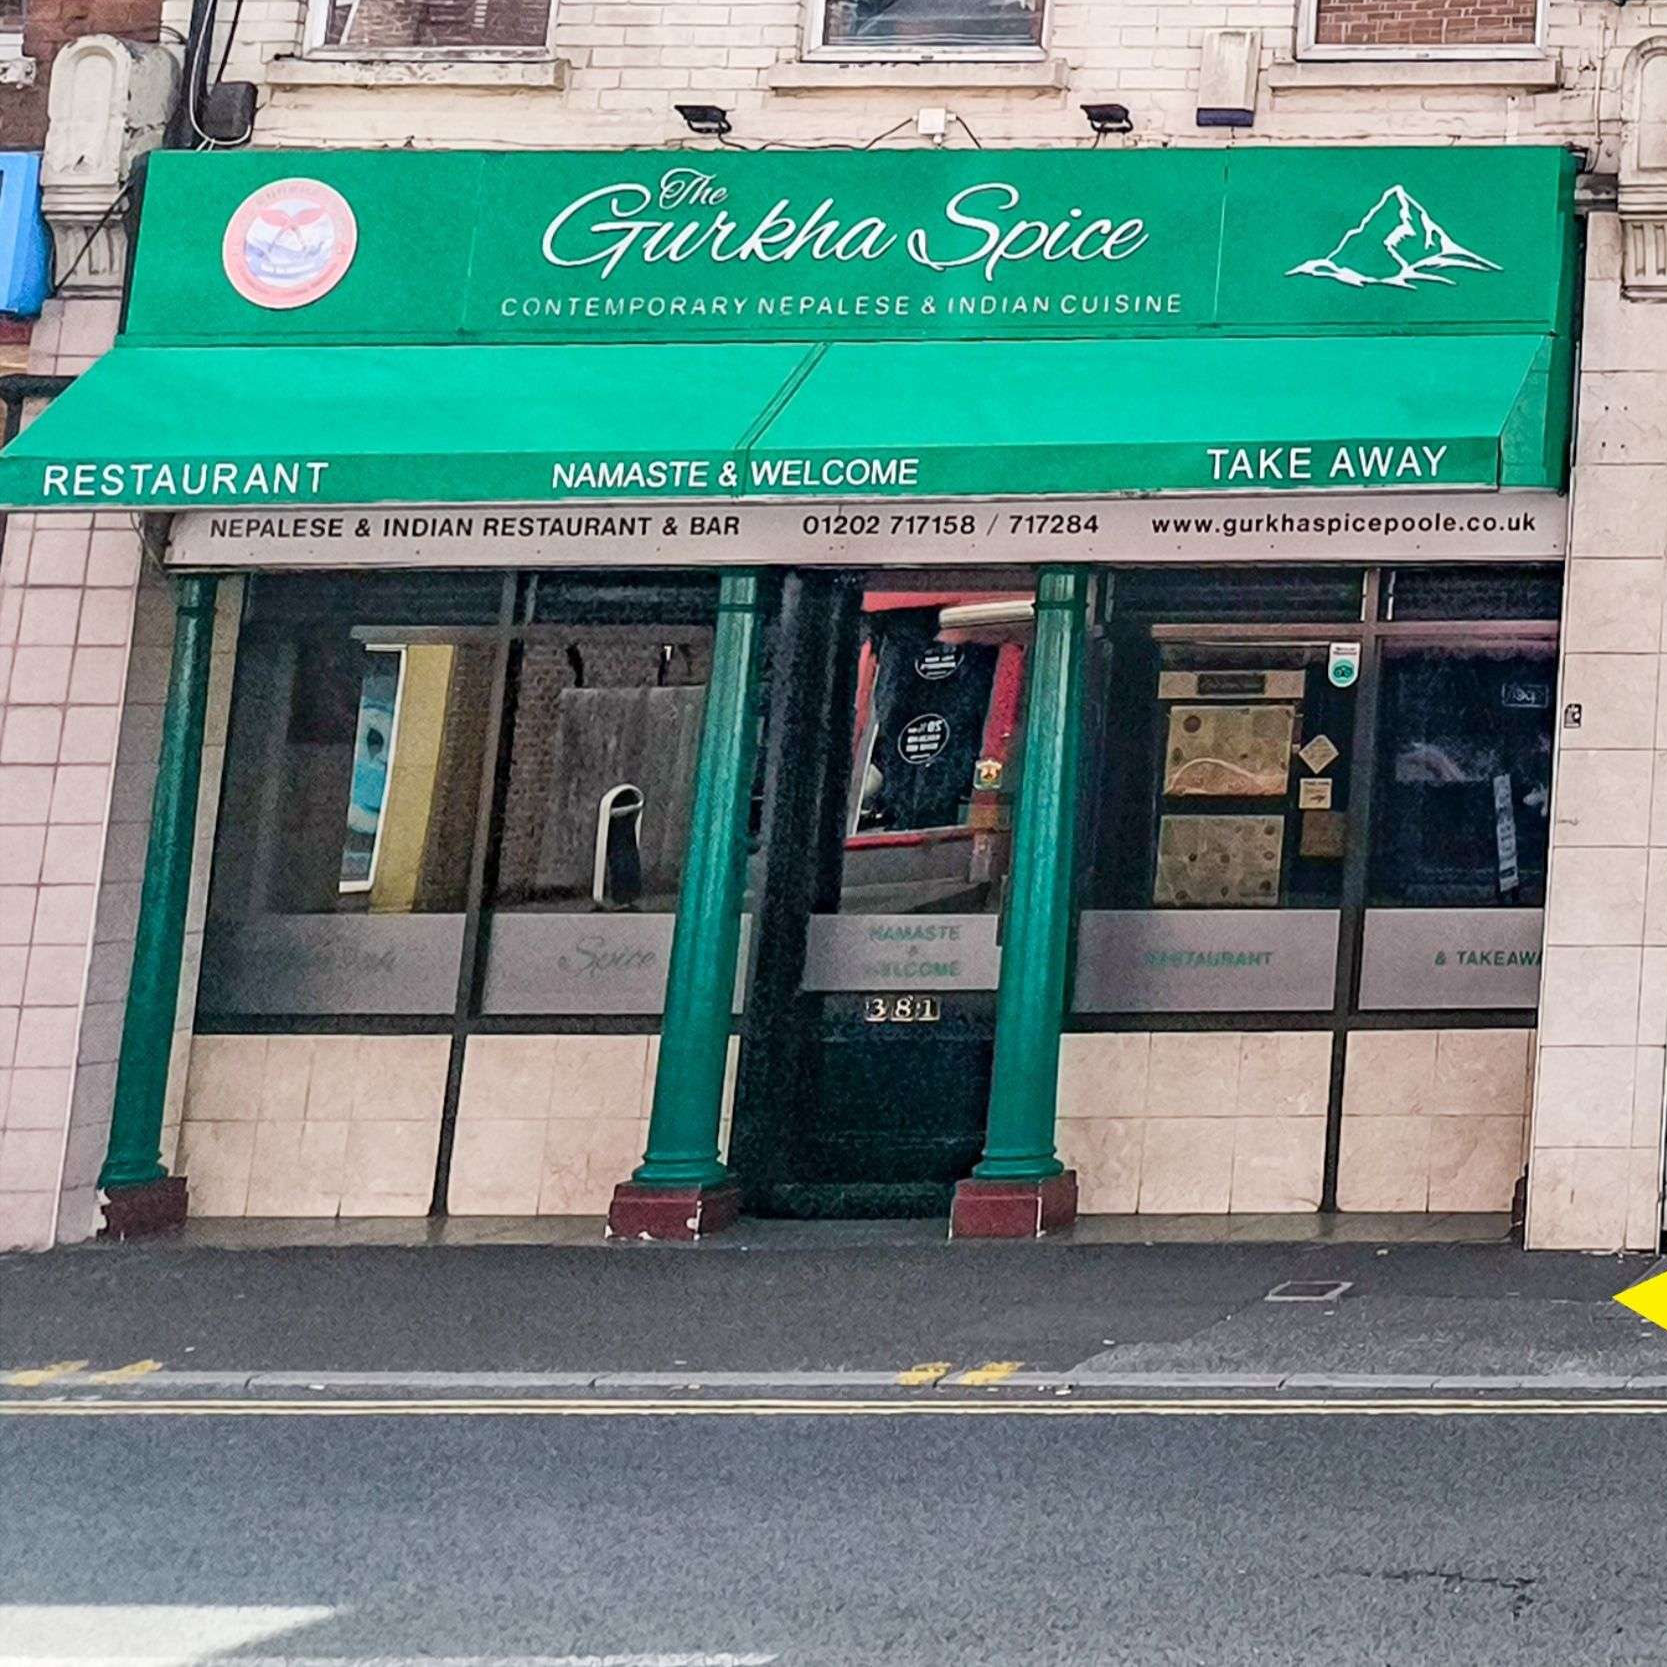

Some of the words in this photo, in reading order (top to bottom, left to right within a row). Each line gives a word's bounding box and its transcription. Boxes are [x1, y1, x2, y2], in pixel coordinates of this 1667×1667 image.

[660, 168, 728, 206] The
[542, 182, 897, 280] Gurkha
[907, 182, 1149, 282] Spice
[501, 297, 748, 319] CONTEMPORARY
[757, 295, 910, 317] NEPALESE
[921, 294, 937, 316] &
[947, 294, 1051, 316] INDIAN
[1060, 293, 1183, 315] CUISINE
[42, 460, 330, 498] RESTAURANT
[551, 460, 711, 490] NAMASTE
[718, 460, 739, 489] &
[750, 457, 919, 488] WELCOME
[1206, 446, 1312, 481] TAKE
[1328, 444, 1448, 479] AWAY
[210, 515, 343, 538] NEPALESE
[354, 515, 371, 538] &
[382, 515, 474, 538] INDIAN
[482, 514, 654, 538] RESTAURANT
[662, 514, 679, 537] &
[689, 514, 741, 537] BAR
[803, 513, 880, 536] 01202
[890, 513, 976, 536] 717158
[1009, 512, 1100, 536] 717284
[1150, 510, 1537, 536] www.gurkhaspicepoole.co.uk
[558, 936, 656, 976] Spice
[867, 996, 936, 1019] 381
